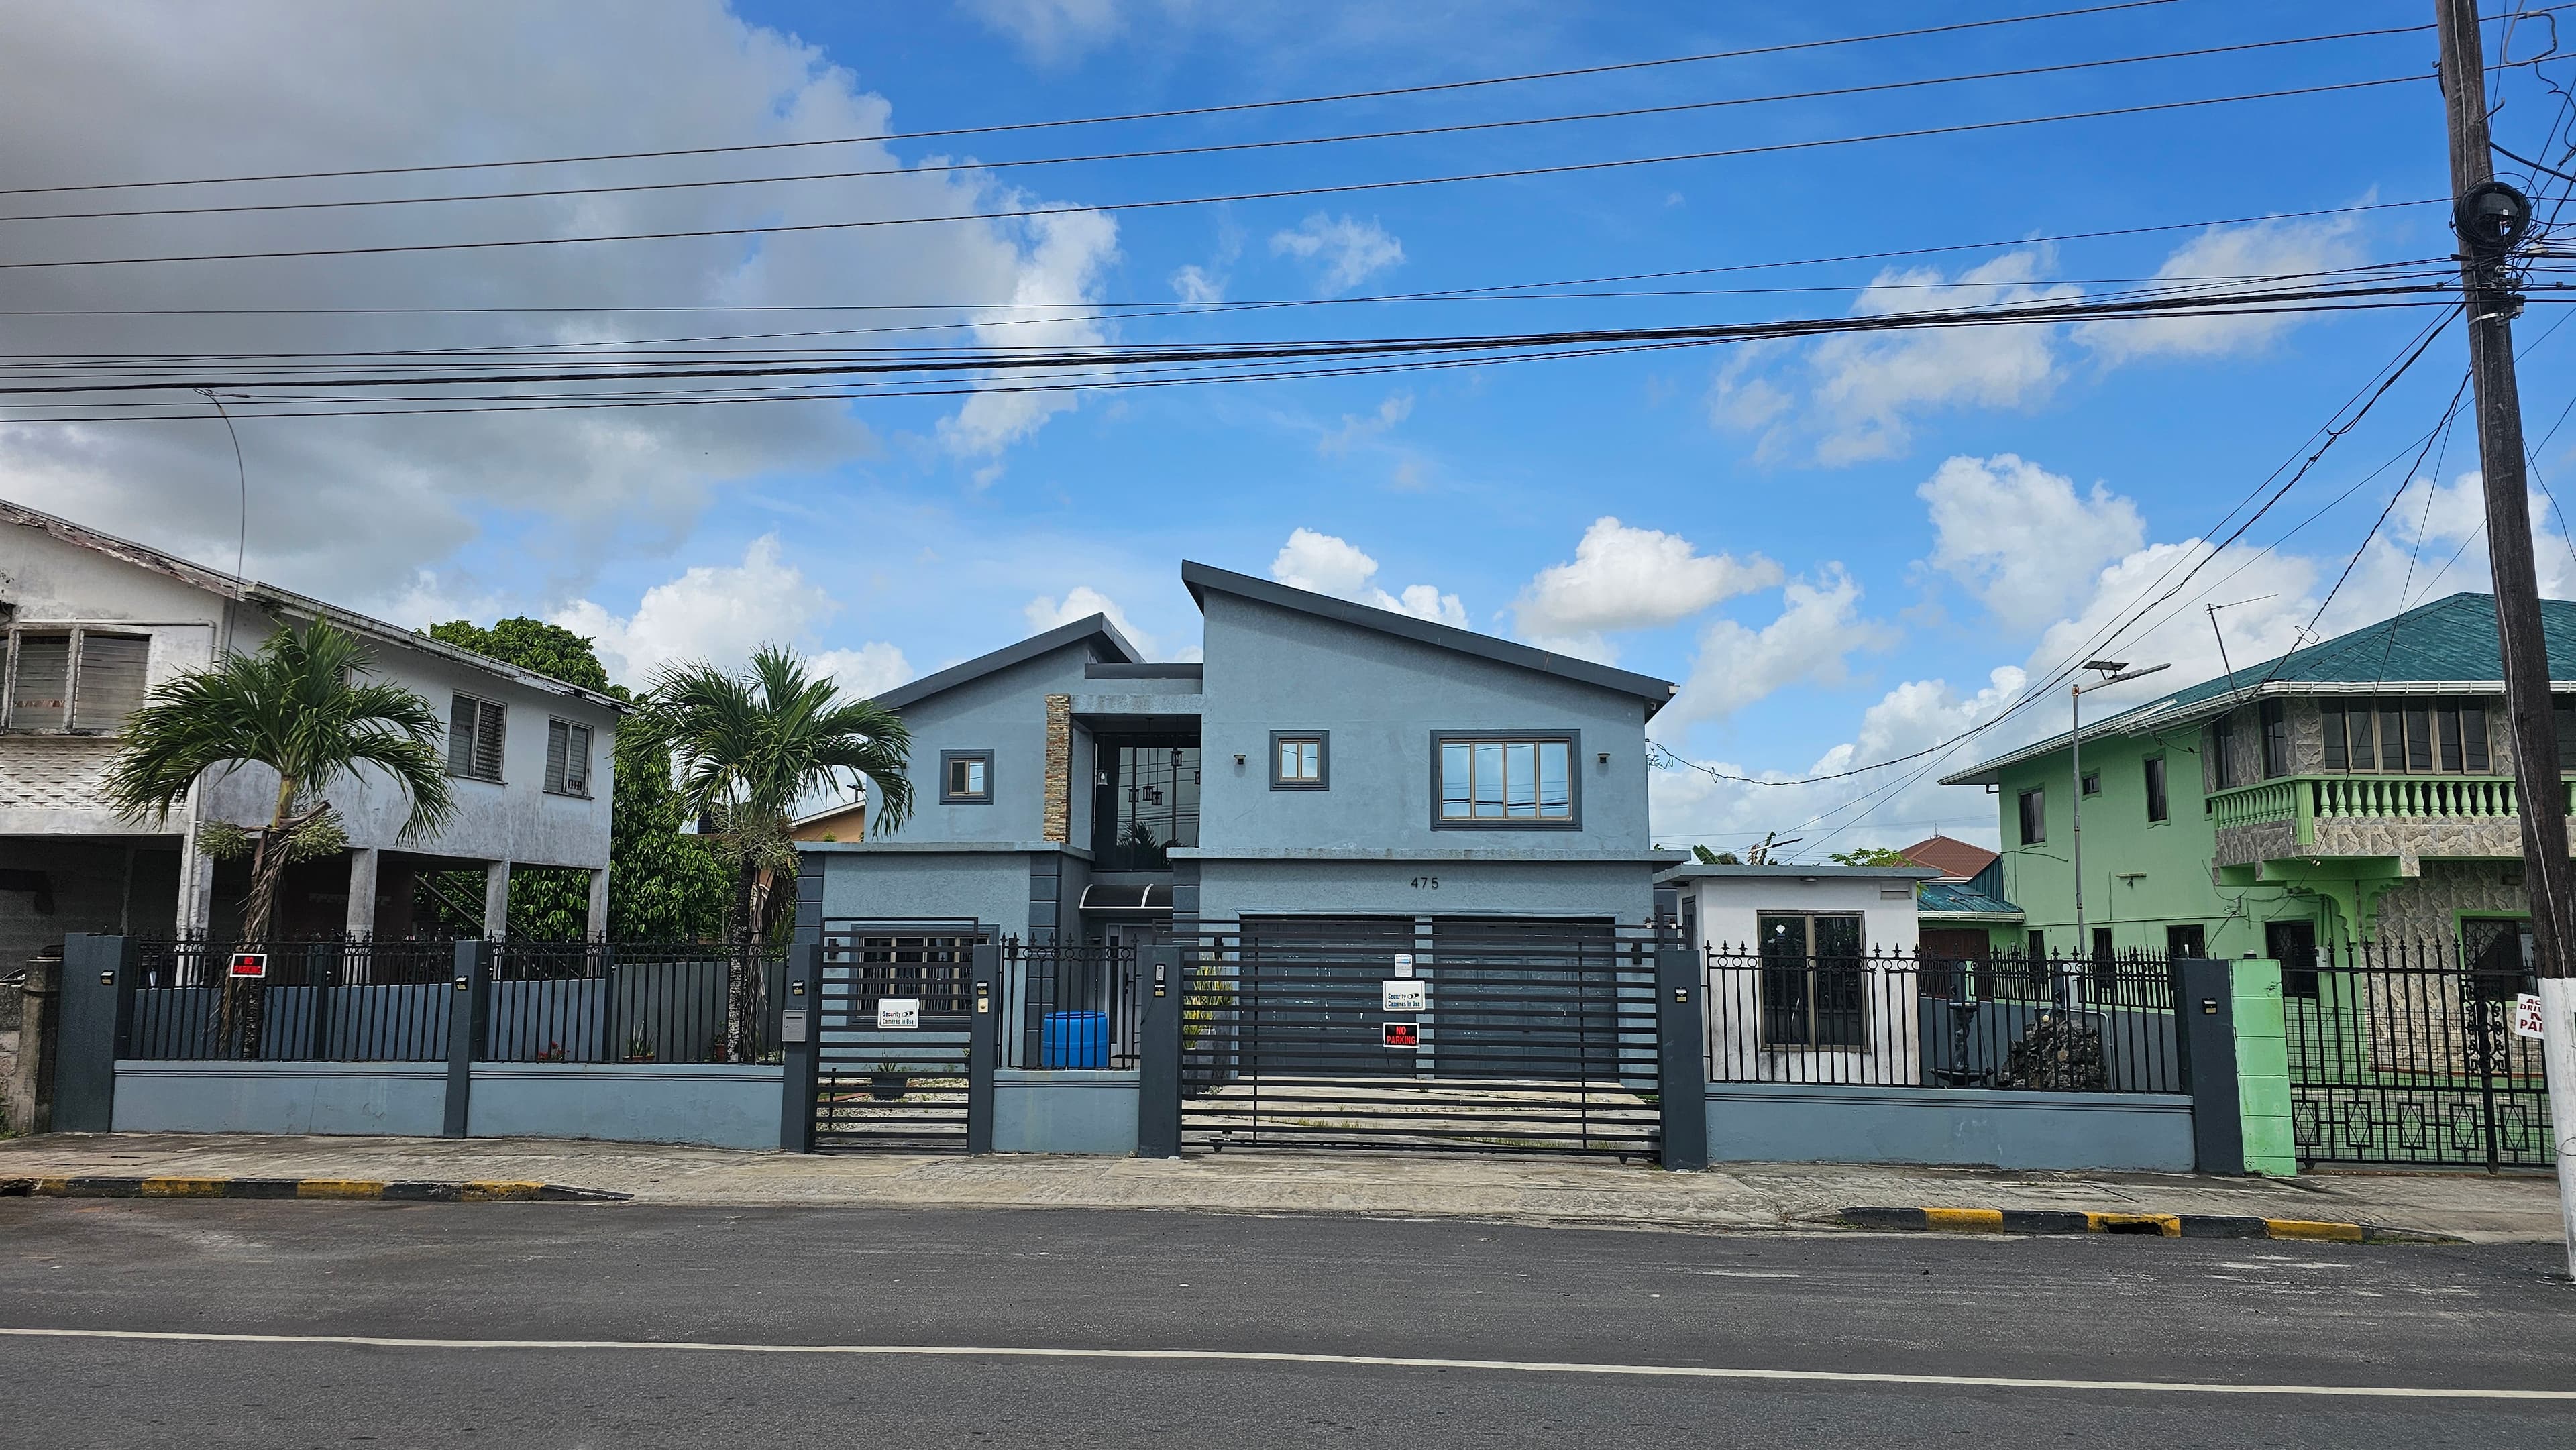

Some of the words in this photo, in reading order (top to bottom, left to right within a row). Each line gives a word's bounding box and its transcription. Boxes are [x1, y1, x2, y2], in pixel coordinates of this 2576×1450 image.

[1411, 877, 1439, 889] 475
[1396, 1026, 1407, 1035] NO
[1387, 1035, 1416, 1044] PARKING
